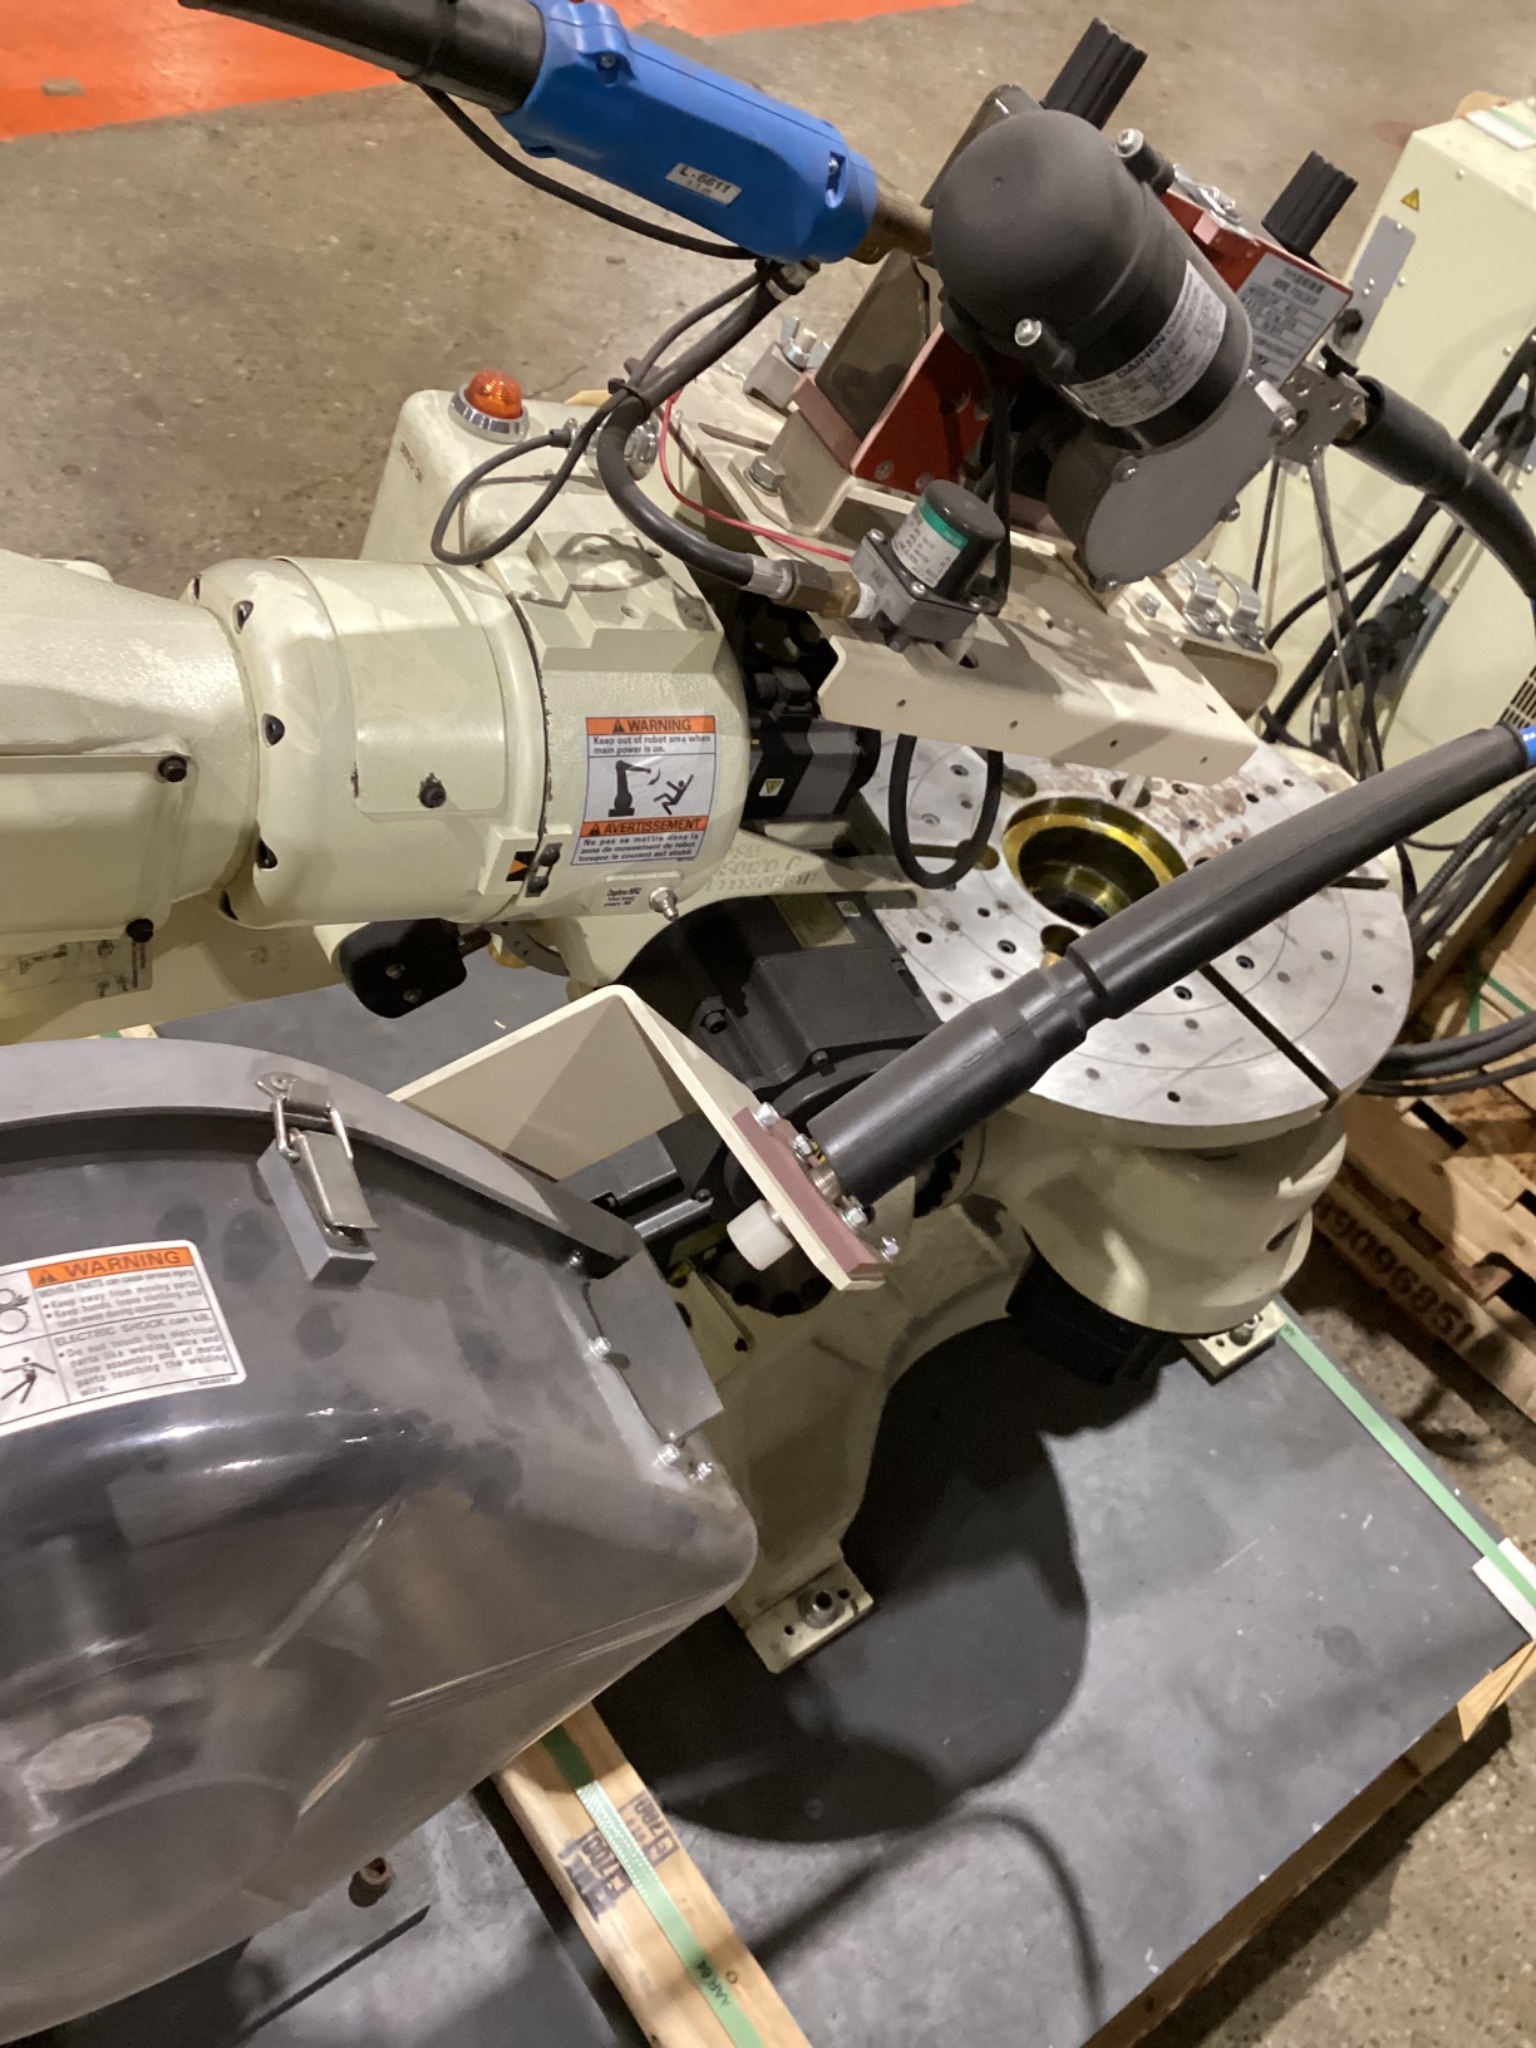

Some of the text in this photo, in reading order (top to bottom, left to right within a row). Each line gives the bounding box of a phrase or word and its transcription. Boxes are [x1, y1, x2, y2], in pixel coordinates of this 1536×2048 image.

[1116, 334, 1166, 378] DAIHEN
[628, 718, 691, 732] WARNING
[594, 737, 614, 745] Keep
[644, 735, 666, 743] robot
[617, 746, 641, 755] power
[604, 818, 701, 833] AVERTISSEMENT
[64, 1250, 180, 1278] WARNING
[50, 1298, 76, 1308] Keep
[54, 1308, 78, 1318] Keep
[54, 1326, 116, 1346] ELECTRIC
[121, 1318, 166, 1332] SHOCK
[169, 1317, 190, 1325] can
[66, 1348, 82, 1358] Do
[111, 1364, 160, 1379] touching
[165, 1360, 182, 1368] the
[187, 1354, 228, 1364] welding
